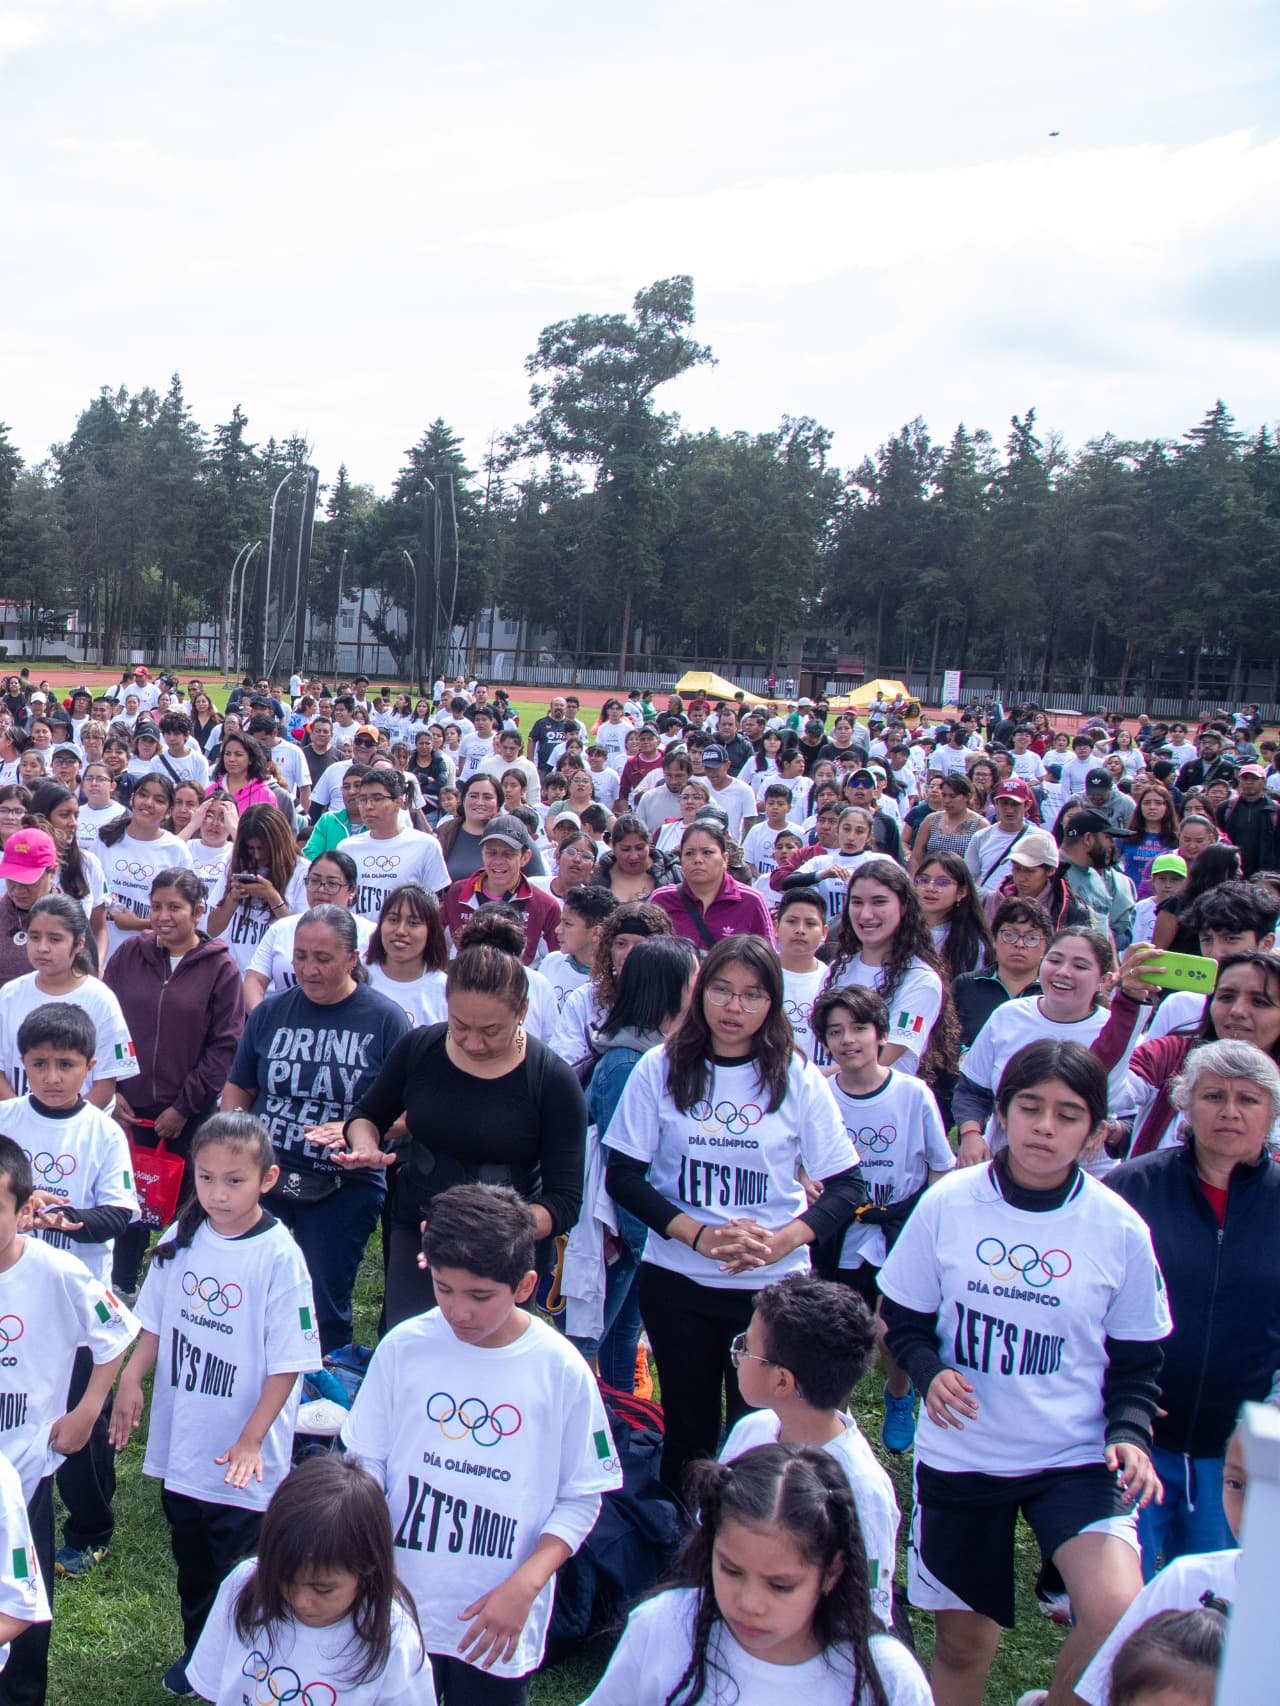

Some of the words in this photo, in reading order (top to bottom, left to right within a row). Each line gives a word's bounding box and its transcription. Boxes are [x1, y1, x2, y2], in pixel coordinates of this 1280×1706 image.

[356, 884, 383, 915] LET'S
[267, 1026, 374, 1068] DRINK
[267, 1058, 363, 1103] PLAY
[687, 1135, 707, 1147] DÍA
[708, 1136, 759, 1151] OLÍMPICO
[678, 1153, 732, 1209] LET'S
[733, 1168, 769, 1207] MOVE
[966, 1279, 991, 1296] DÍA
[992, 1282, 1061, 1308] OLÍMPICO
[953, 1301, 1018, 1377] LET'S
[1017, 1328, 1066, 1377] MOVE
[200, 1351, 237, 1399] MOVE
[422, 1450, 443, 1466] DÍA
[444, 1459, 512, 1483] OLÍMPICO
[393, 1474, 468, 1554] LET'S
[468, 1503, 519, 1560] MOVE
